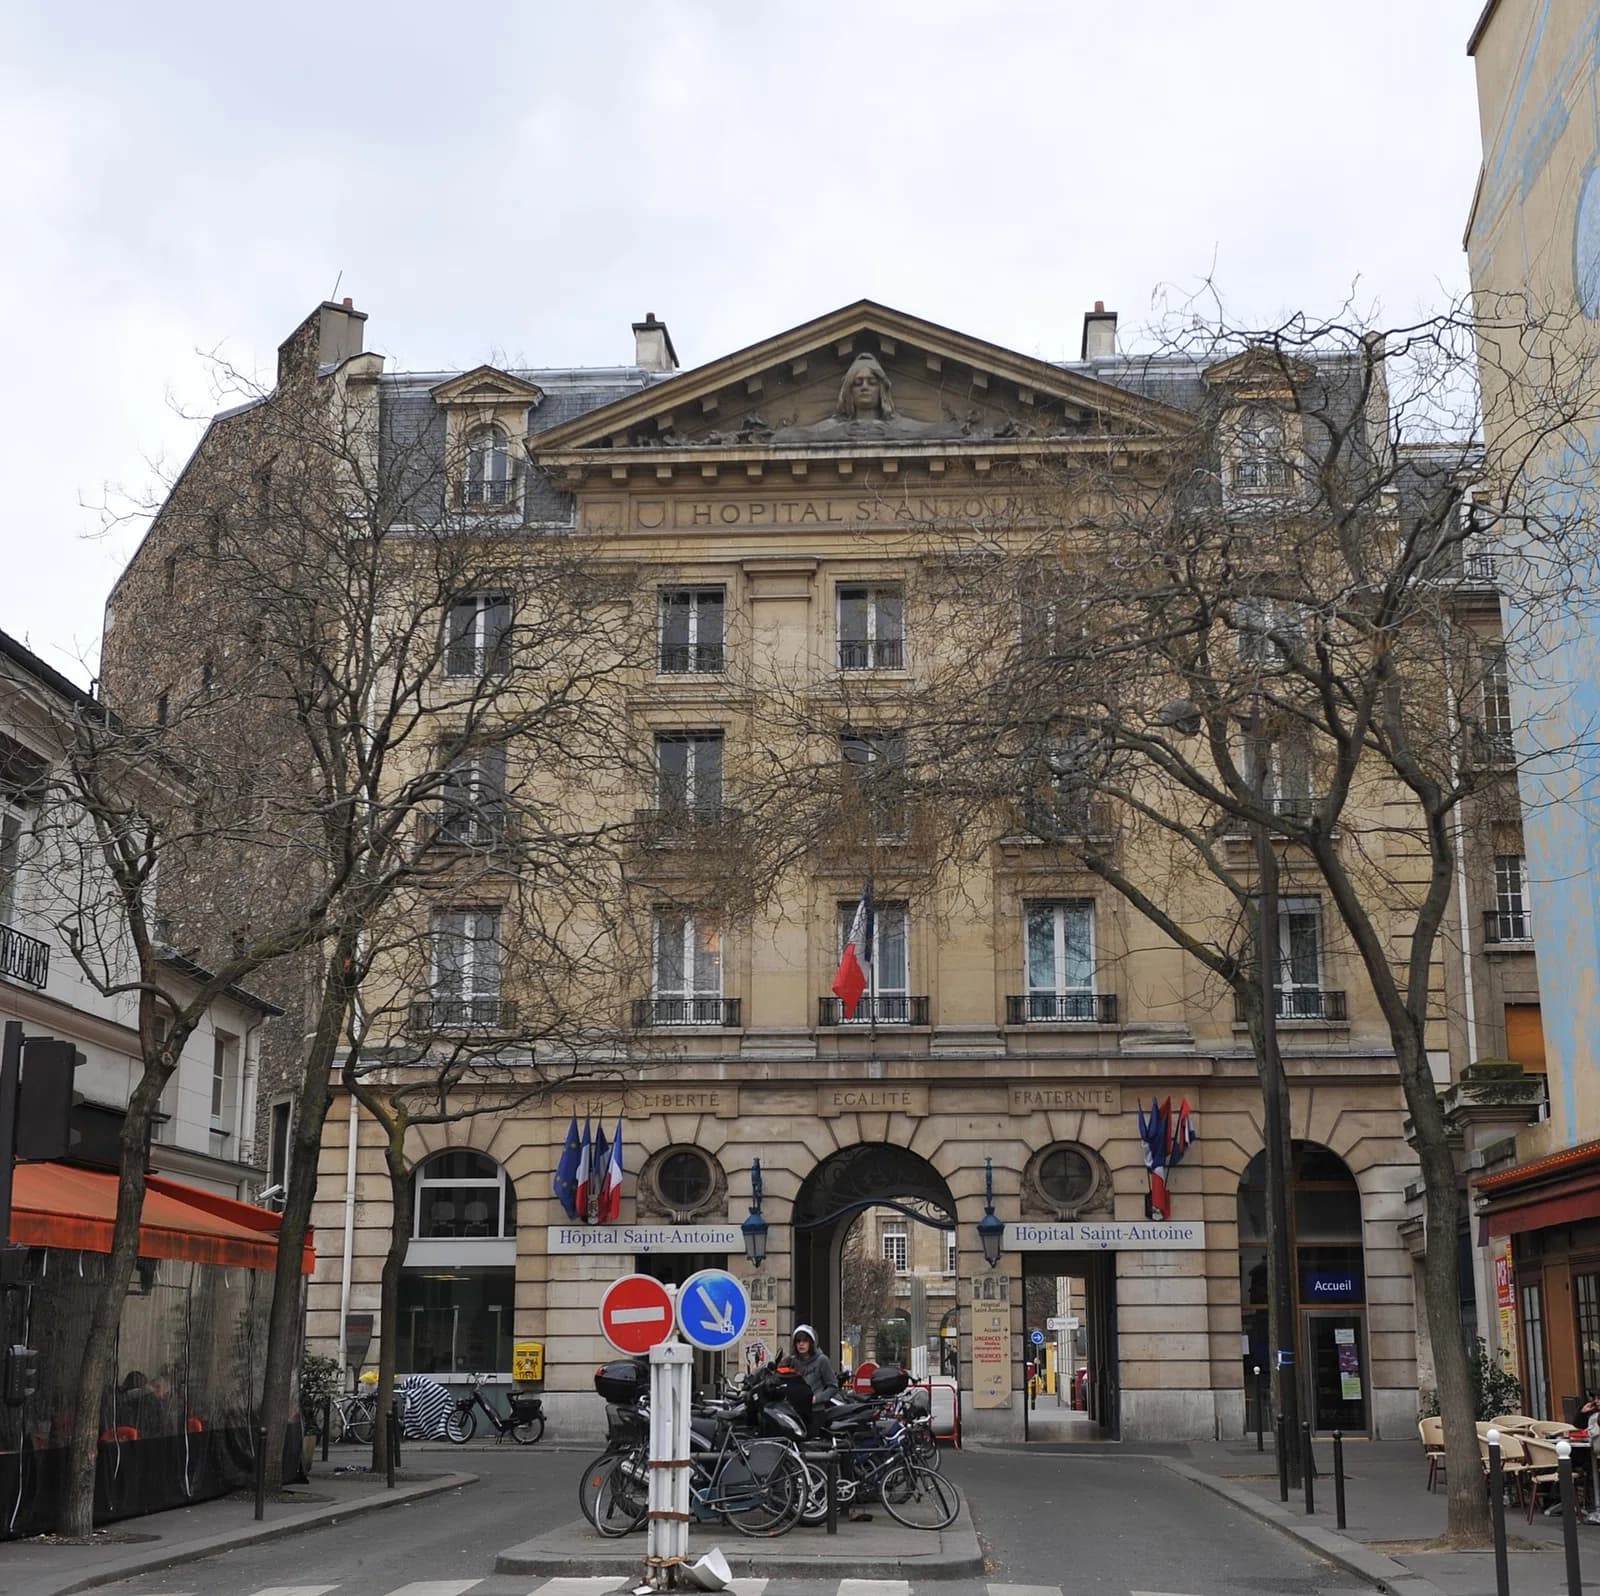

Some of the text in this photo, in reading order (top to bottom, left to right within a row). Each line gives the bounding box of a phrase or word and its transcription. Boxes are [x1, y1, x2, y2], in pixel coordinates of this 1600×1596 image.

[692, 502, 842, 524] HOPITAL
[644, 1091, 720, 1107] LIBERTÉ
[833, 1088, 912, 1105] ÉGALITÉ
[1014, 1088, 1113, 1105] FRATERNITÉ
[560, 1229, 735, 1247] Hôpital Saint-Antoine
[1015, 1226, 1193, 1243] Hôpital Saint-Antoine
[1314, 1279, 1352, 1291] Accueil
